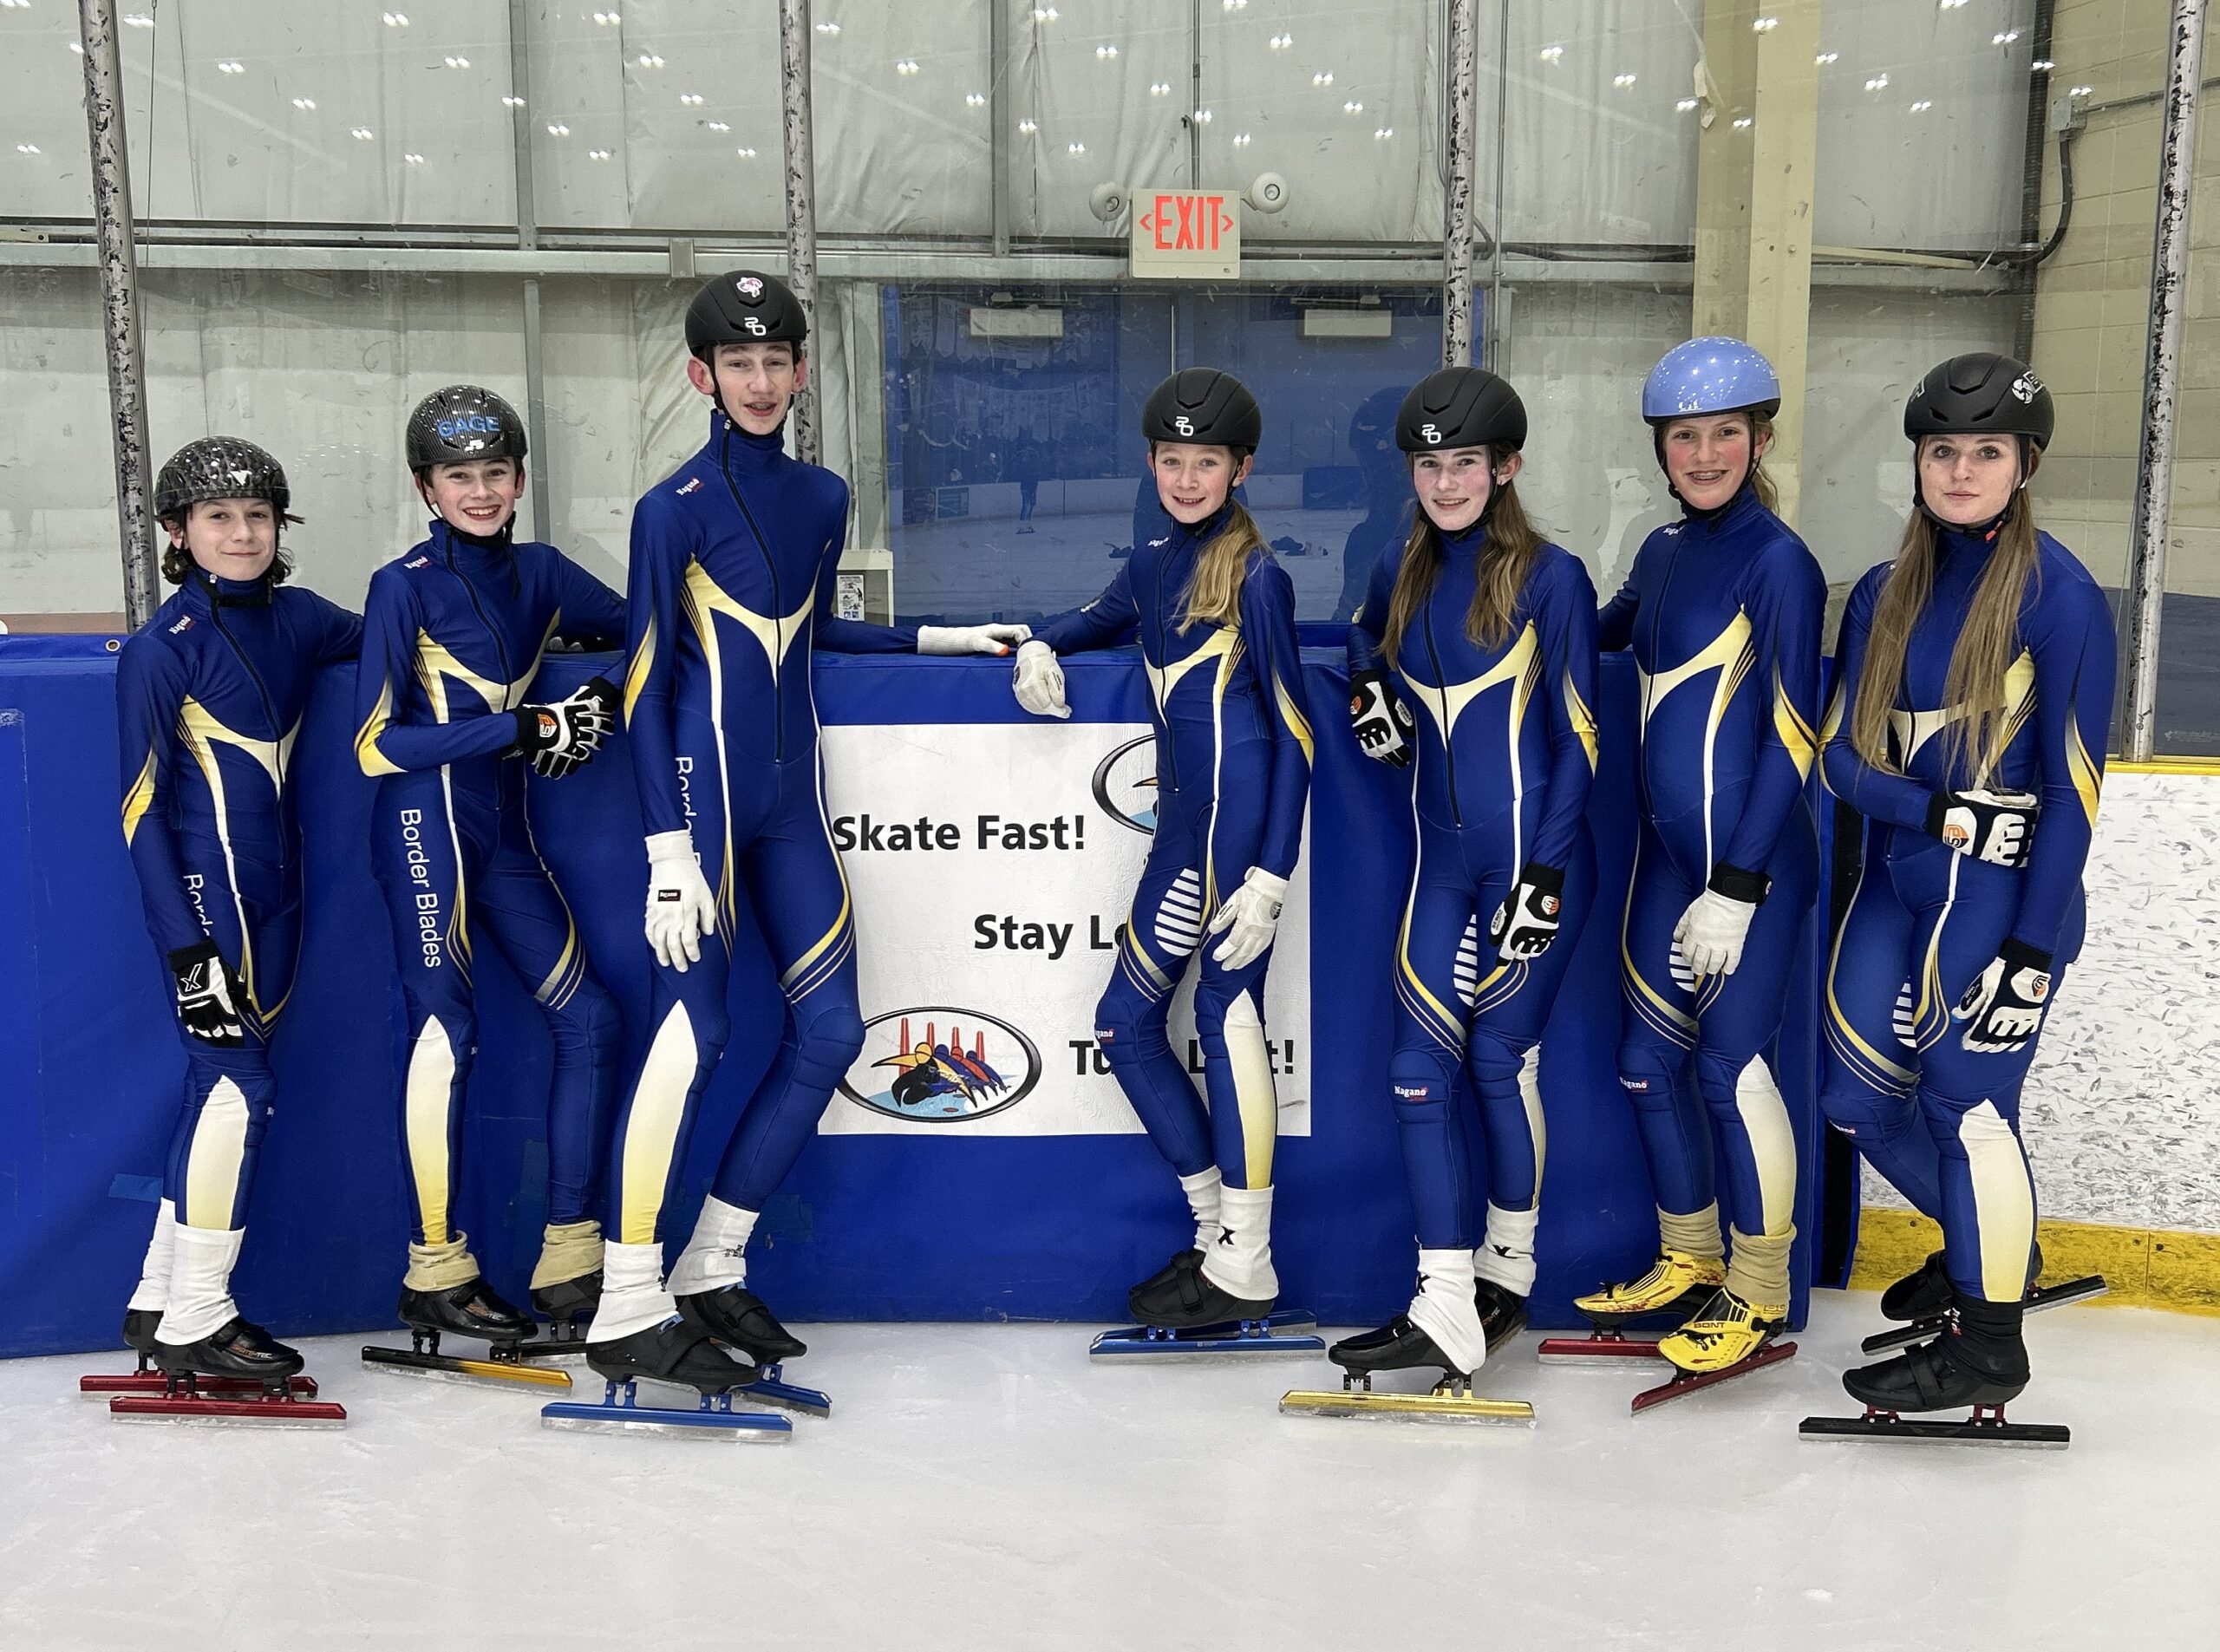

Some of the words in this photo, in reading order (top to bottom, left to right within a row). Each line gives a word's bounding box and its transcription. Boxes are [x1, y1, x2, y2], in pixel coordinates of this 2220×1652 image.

[1155, 196, 1224, 251] EXIT
[436, 415, 500, 437] GAGE
[401, 809, 430, 888] Border
[832, 813, 961, 852] Skate
[977, 814, 1084, 850] Fast!
[415, 893, 444, 968] Blades
[974, 914, 1074, 960] Stay
[1394, 1085, 1427, 1098] Nagano
